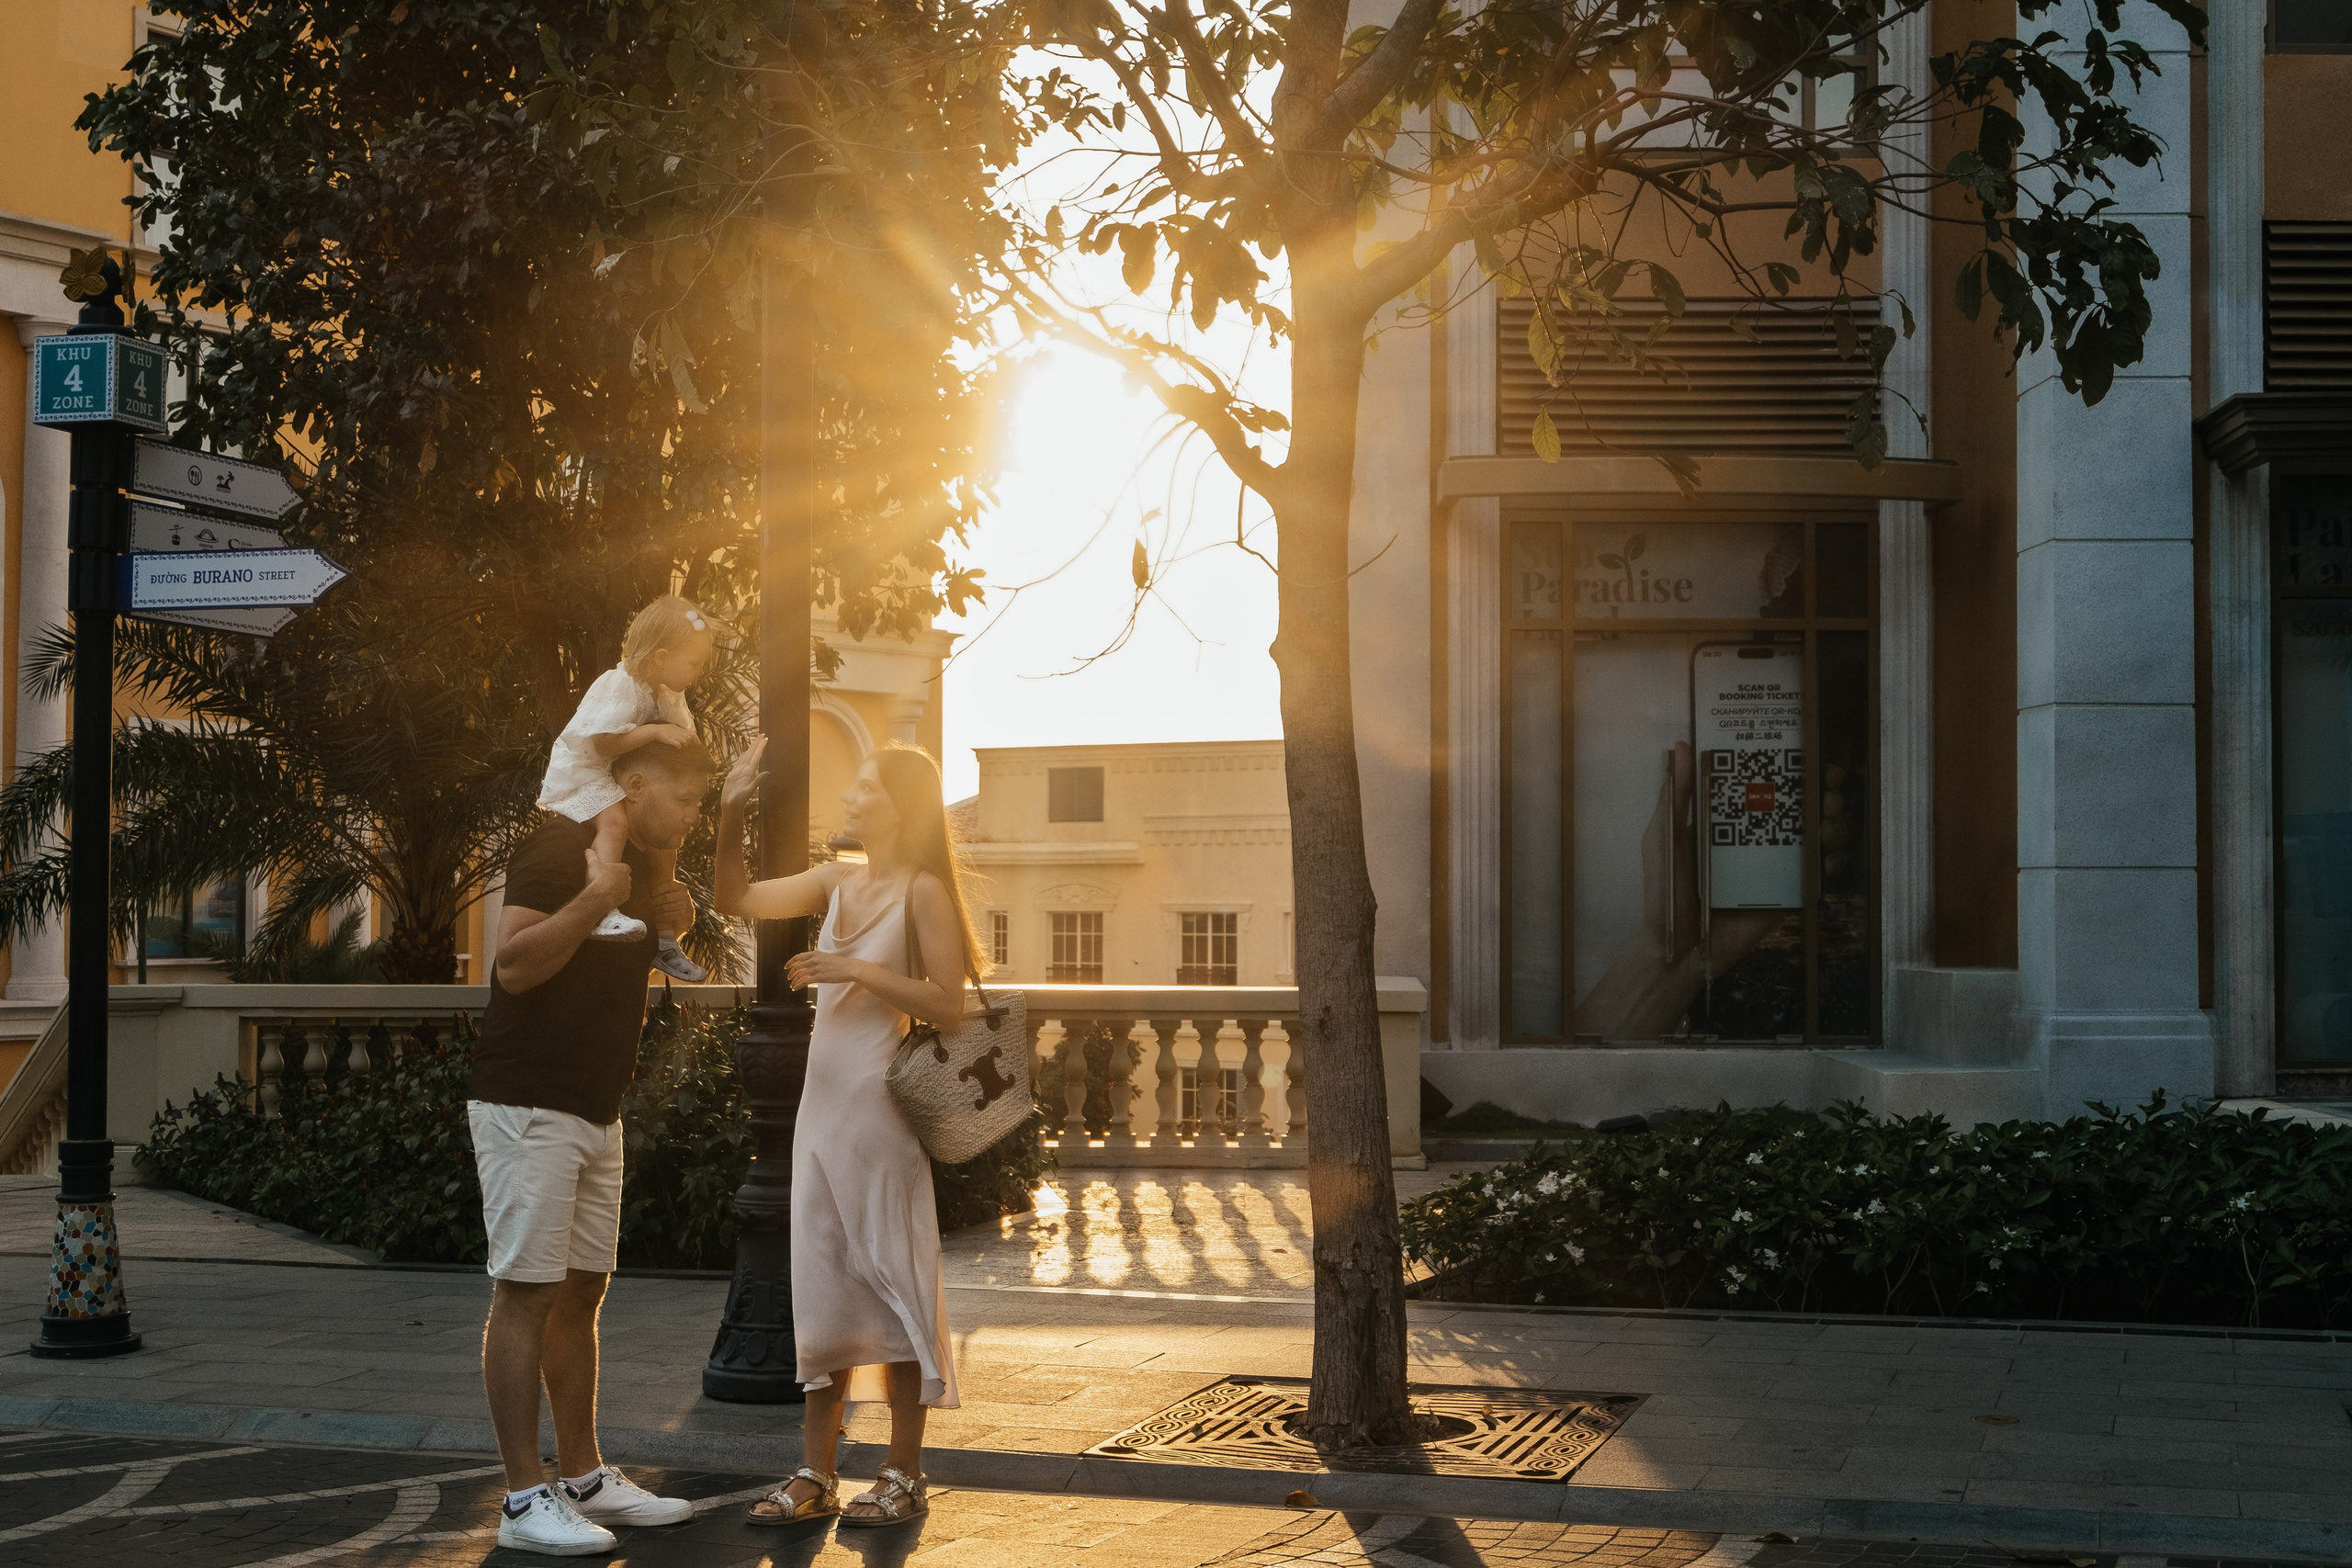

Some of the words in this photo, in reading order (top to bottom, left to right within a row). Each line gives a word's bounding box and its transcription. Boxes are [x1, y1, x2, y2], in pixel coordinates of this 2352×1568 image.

[56, 347, 91, 361] KHU
[130, 350, 153, 368] KHU
[63, 365, 84, 392] 4
[133, 370, 147, 399] 4
[52, 395, 94, 410] ZONE
[126, 398, 153, 417] ZONE
[2286, 506, 2352, 547] Pa
[150, 571, 187, 584] ĐƯỜNG
[193, 569, 254, 584] BURANO
[258, 570, 296, 581] STREET
[1521, 569, 1694, 604] Paradise
[1711, 705, 1770, 716] СКАНИРУЙТЕ
[1771, 707, 1802, 716] QR-КО
